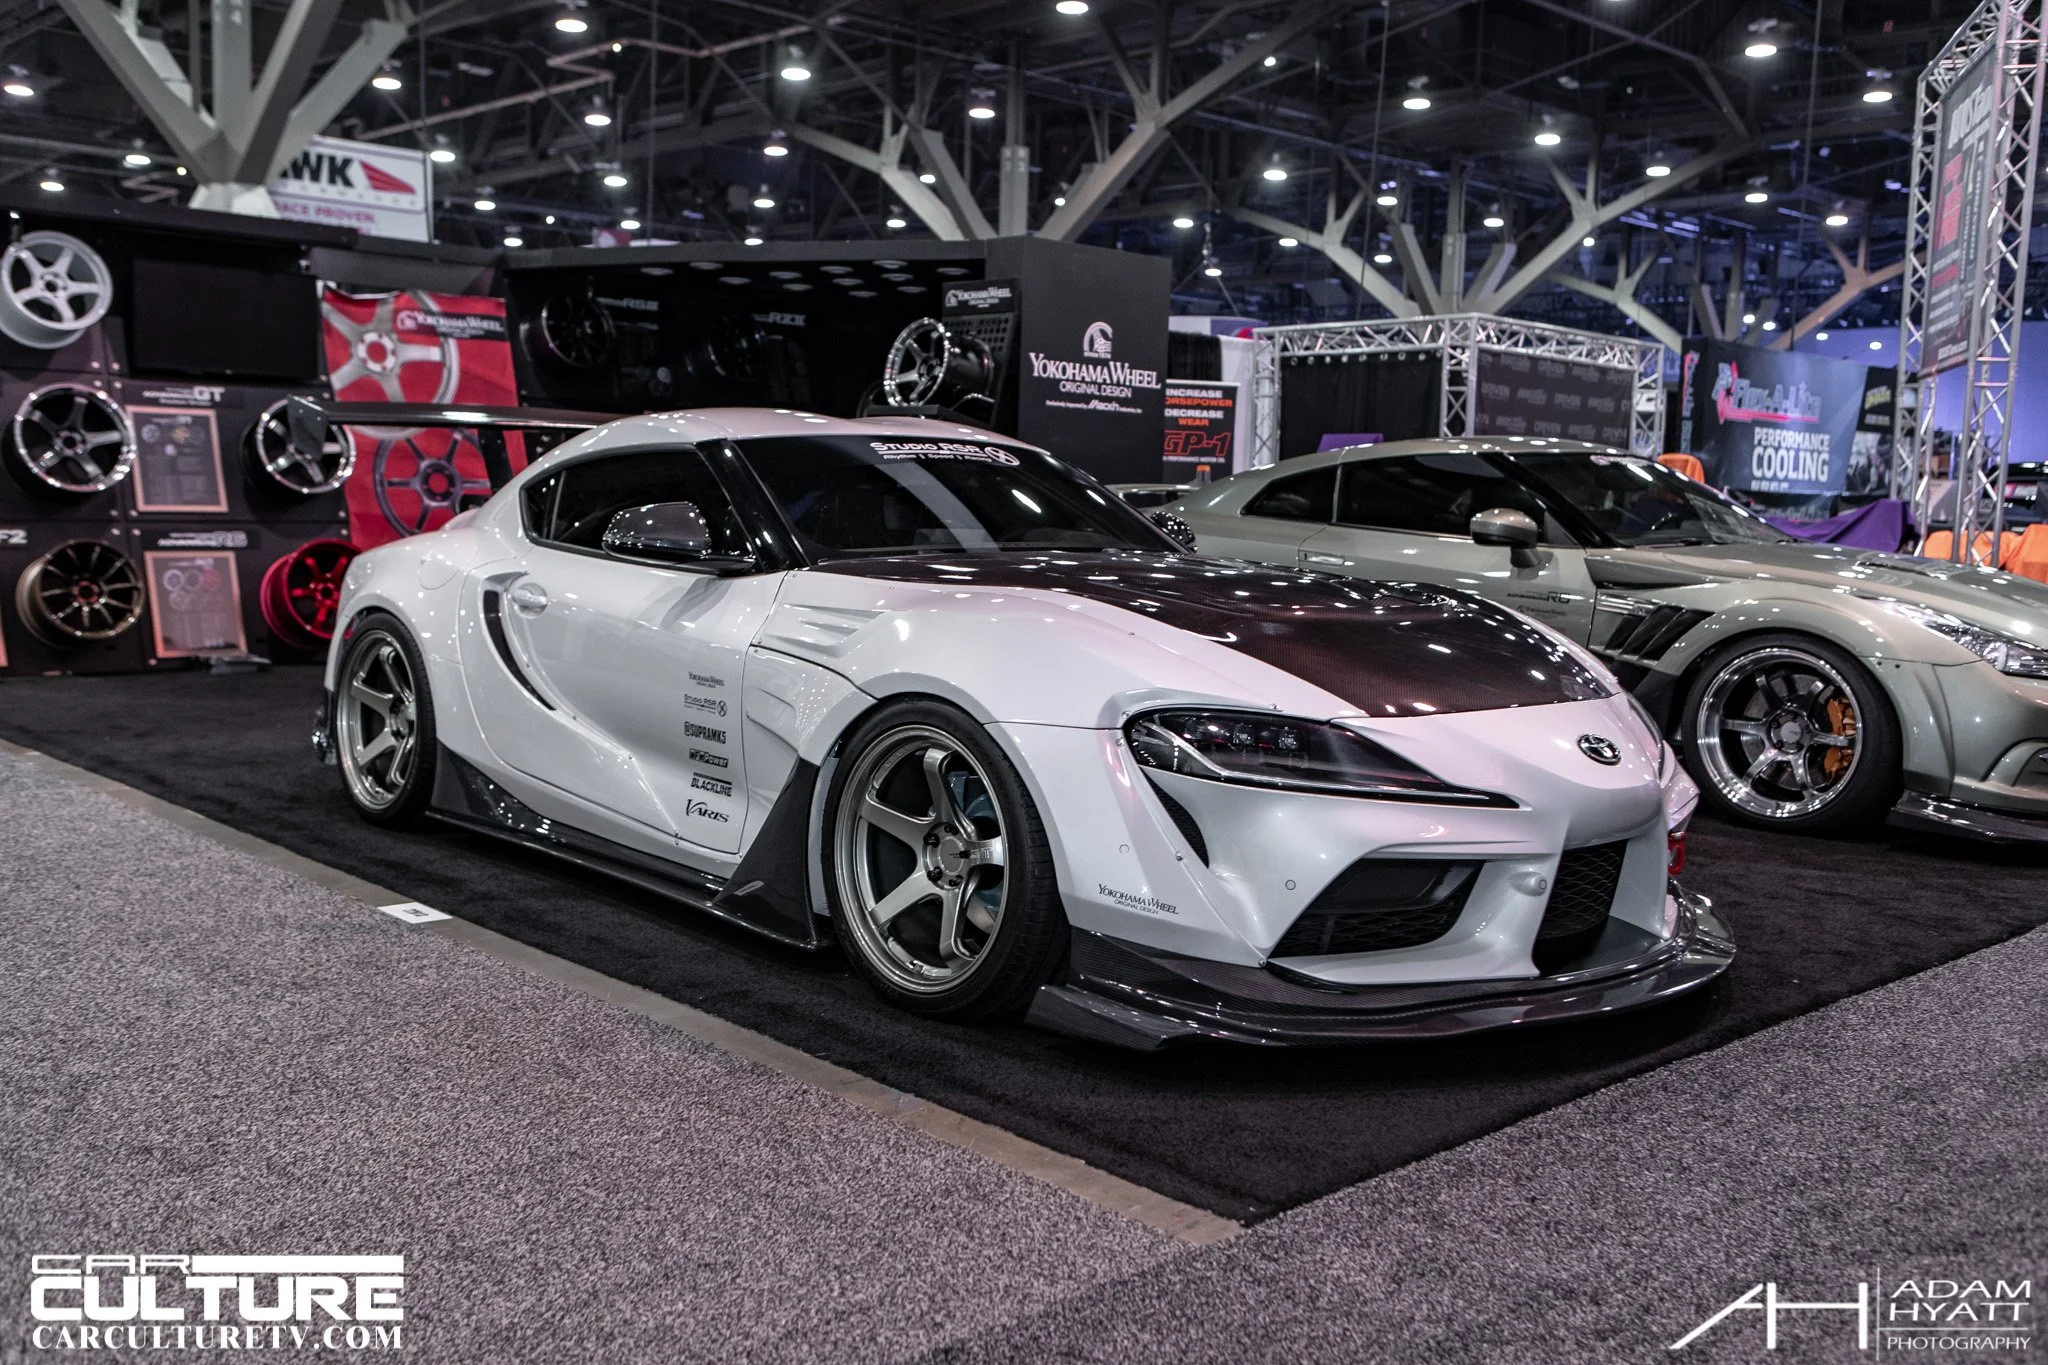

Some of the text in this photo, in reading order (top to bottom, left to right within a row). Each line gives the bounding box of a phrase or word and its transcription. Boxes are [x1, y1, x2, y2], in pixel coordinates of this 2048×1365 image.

[280, 152, 353, 188] WK
[1029, 352, 1161, 389] YOKOHAMA WHEEL
[1059, 381, 1132, 398] ORIGINAL DESIGN
[1165, 388, 1223, 399] INCREASE
[1164, 408, 1224, 419] DECREASE
[1178, 418, 1209, 426] WEAR
[938, 442, 984, 453] RSR
[1164, 429, 1231, 456] GP-1
[1753, 427, 1831, 450] PERFORMANCE
[1751, 447, 1830, 482] COOLING
[684, 721, 727, 744] @SUPRAMK5
[691, 777, 732, 797] BLACKLINE
[686, 799, 729, 823] VARIS
[1098, 884, 1179, 915] YOKOHAMA WHEEL
[1114, 900, 1159, 915] ORIGINAL DESIGN
